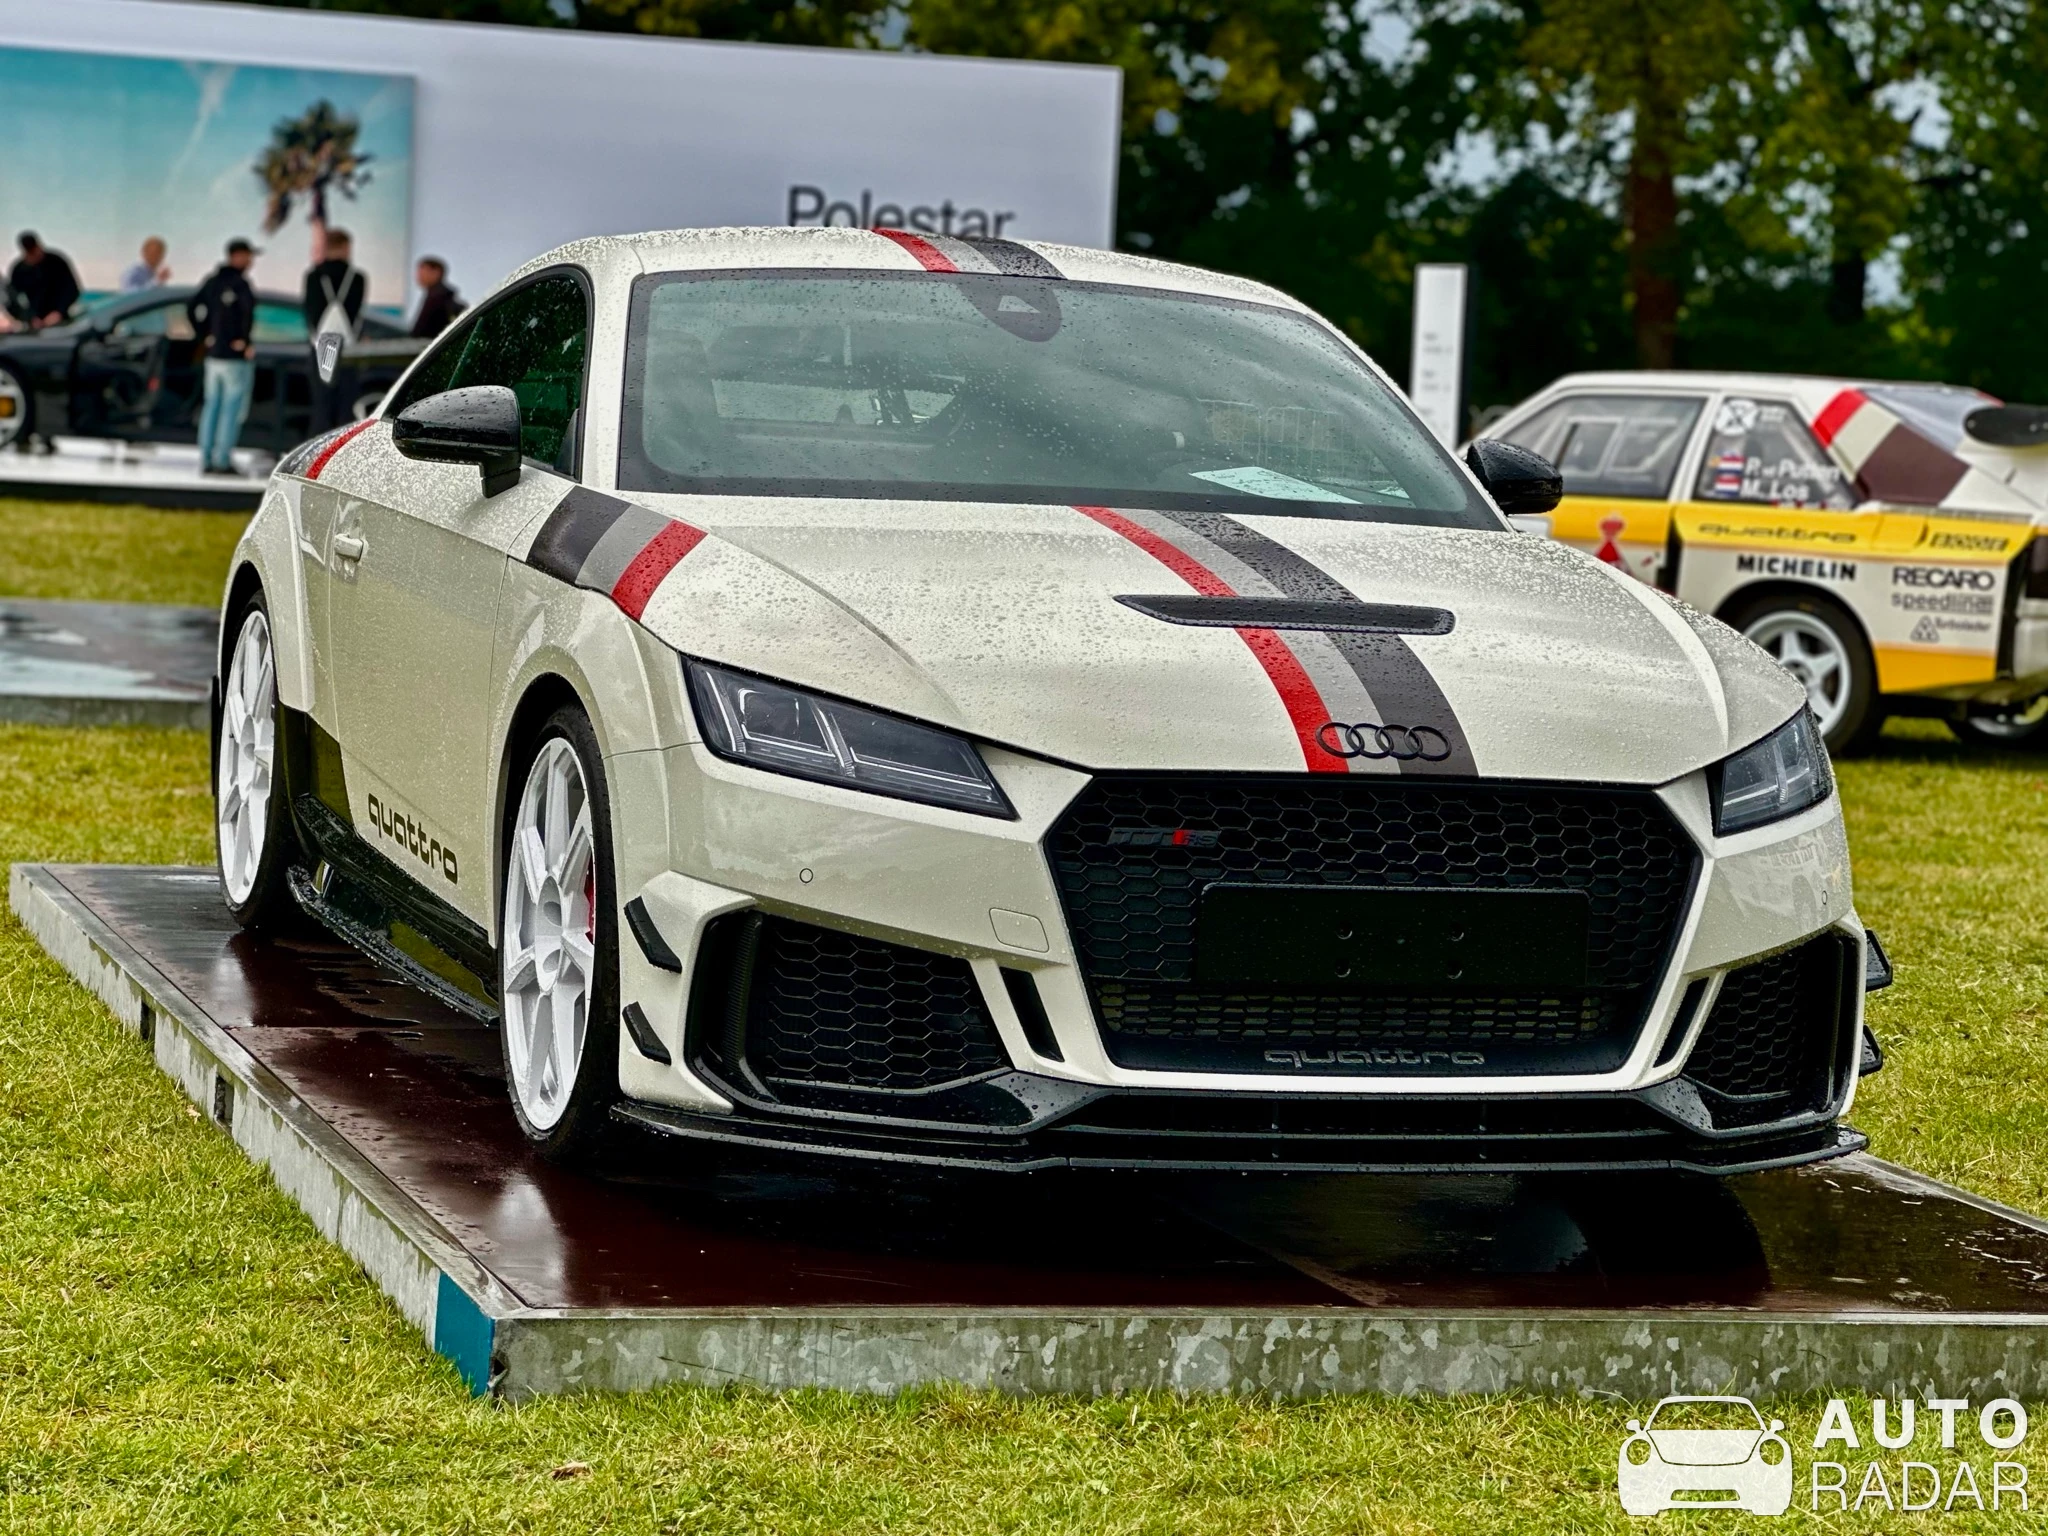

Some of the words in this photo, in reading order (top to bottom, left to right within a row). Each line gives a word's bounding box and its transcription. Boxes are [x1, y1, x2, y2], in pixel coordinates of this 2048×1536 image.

[788, 185, 1016, 238] Polestar
[1699, 523, 1856, 543] quattro
[1736, 554, 1857, 580] MICHELIN
[1892, 566, 1996, 591] RECARO
[367, 792, 458, 885] quattro
[1264, 1047, 1486, 1069] quattro
